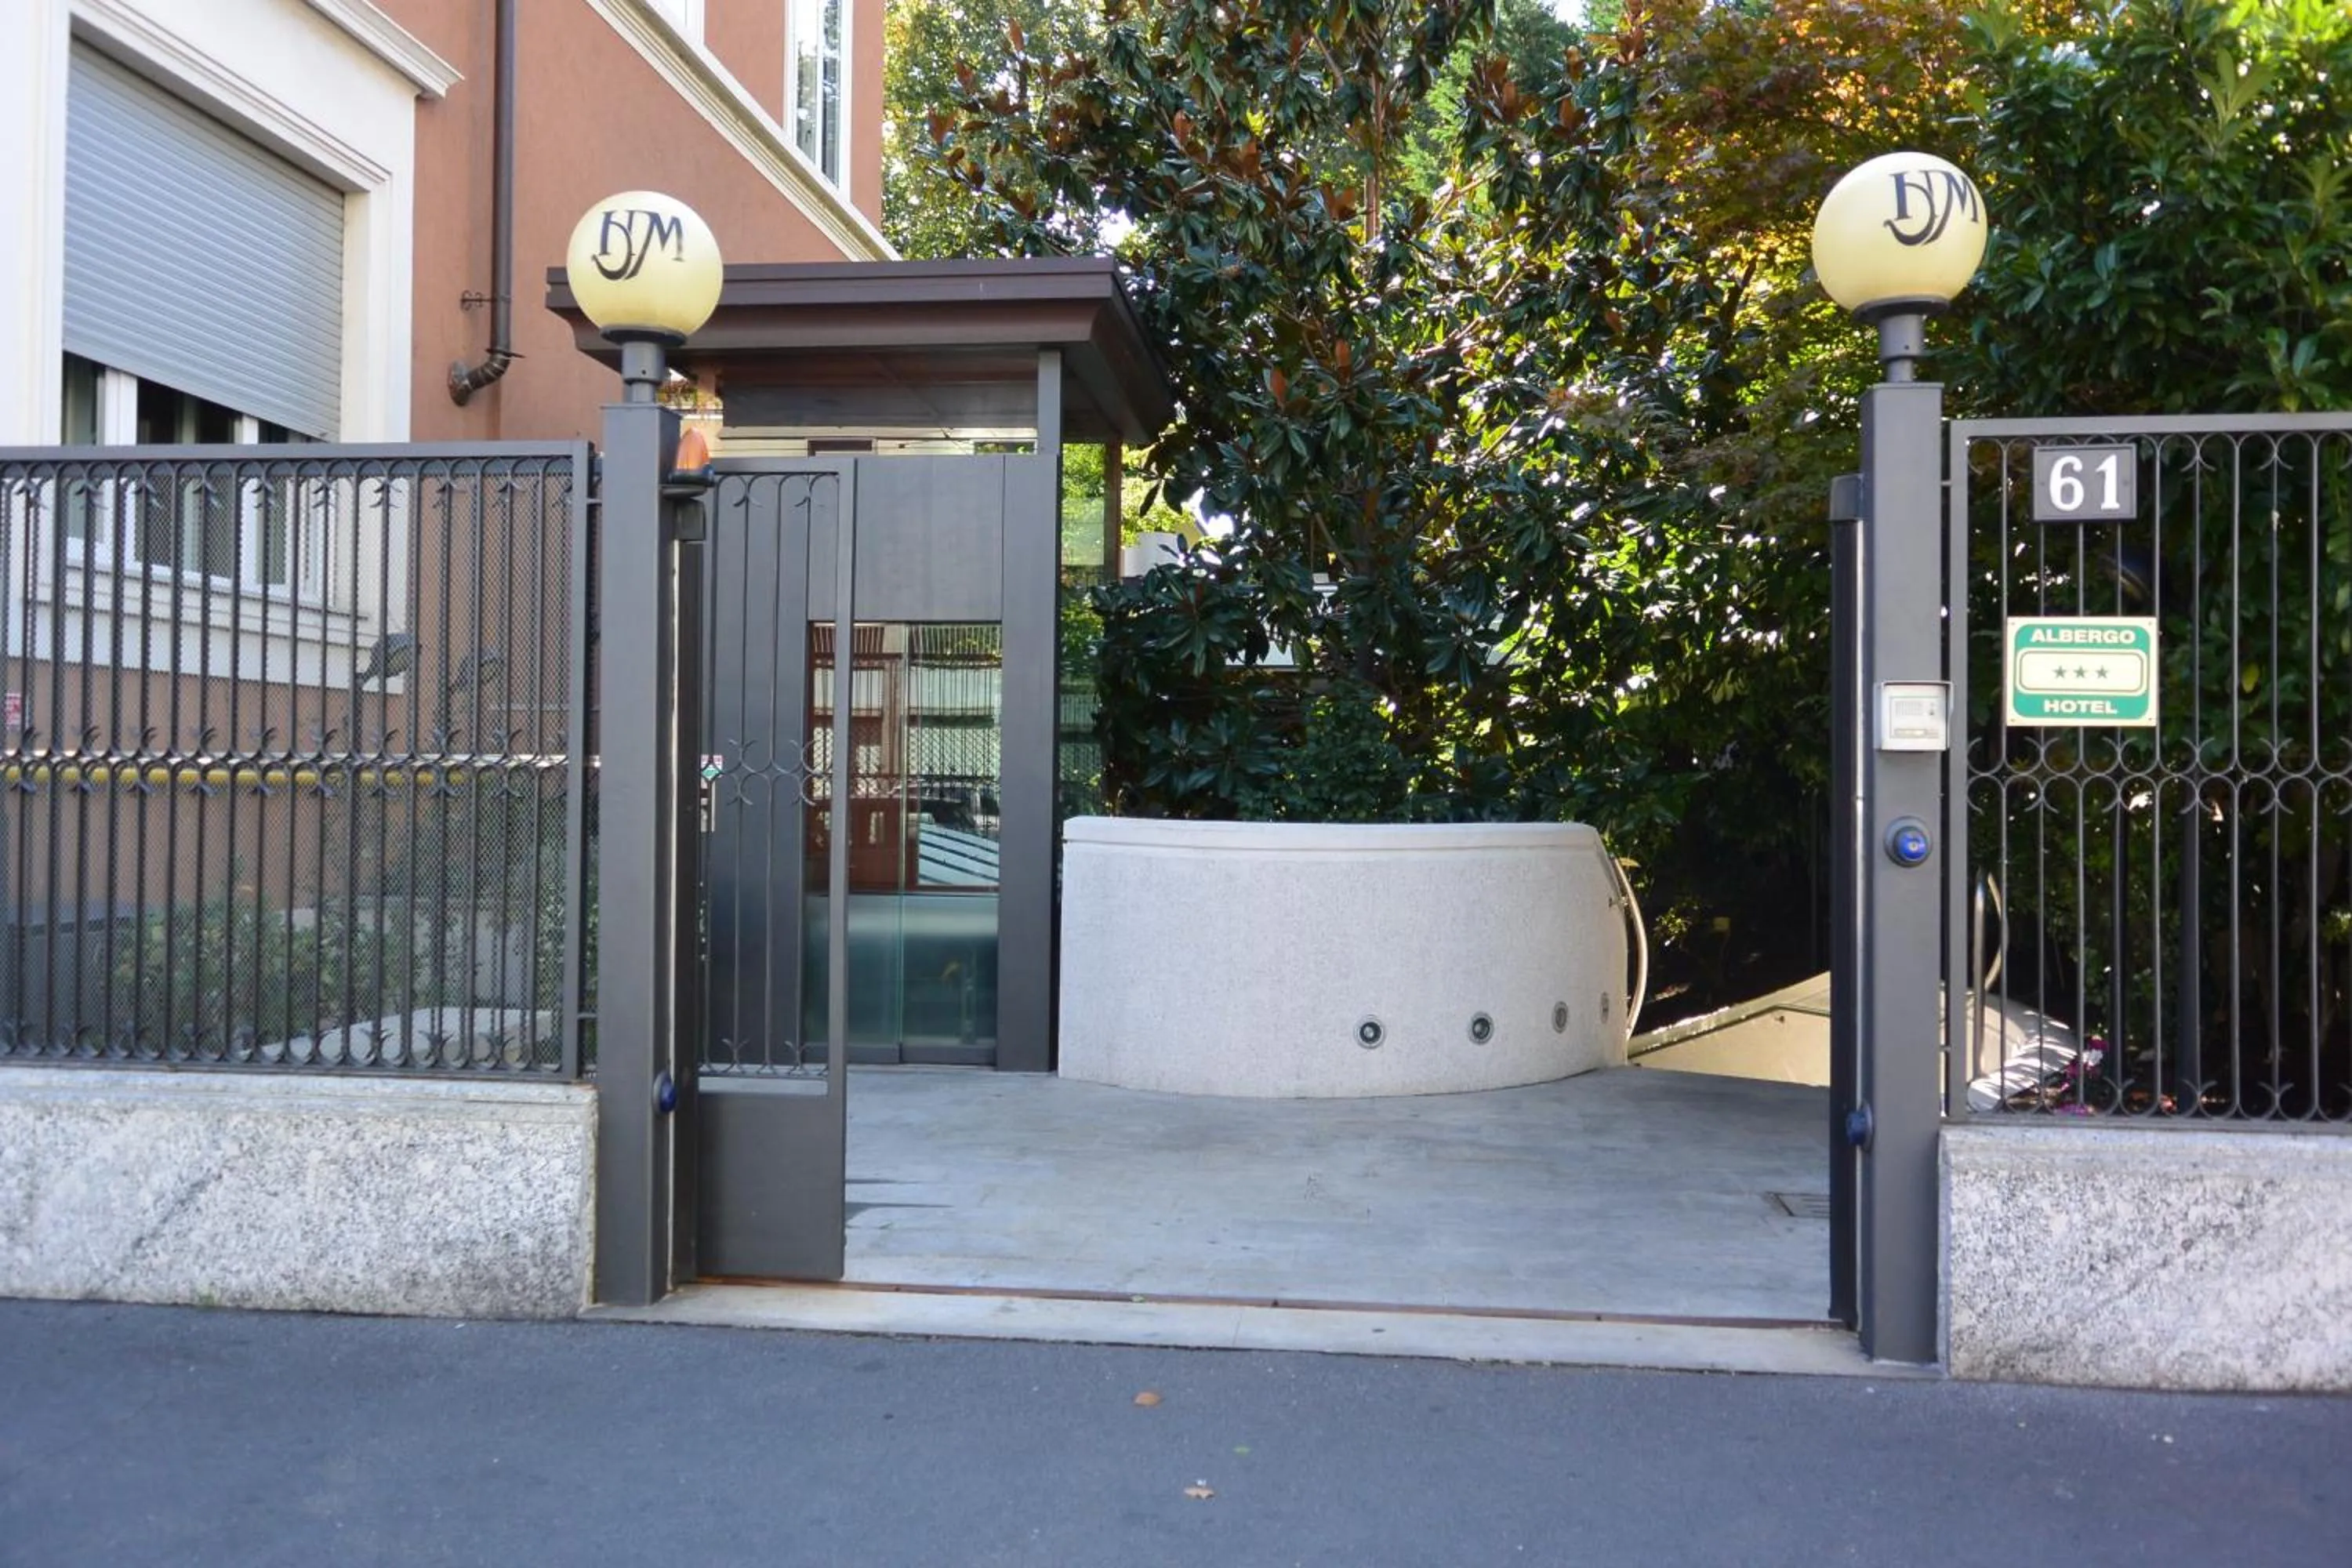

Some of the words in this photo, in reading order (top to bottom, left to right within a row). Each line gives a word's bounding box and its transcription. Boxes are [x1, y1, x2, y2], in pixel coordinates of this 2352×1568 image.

[2049, 454, 2120, 511] 61
[2030, 628, 2136, 644] ALBERGO
[2044, 699, 2118, 714] HOTEL
